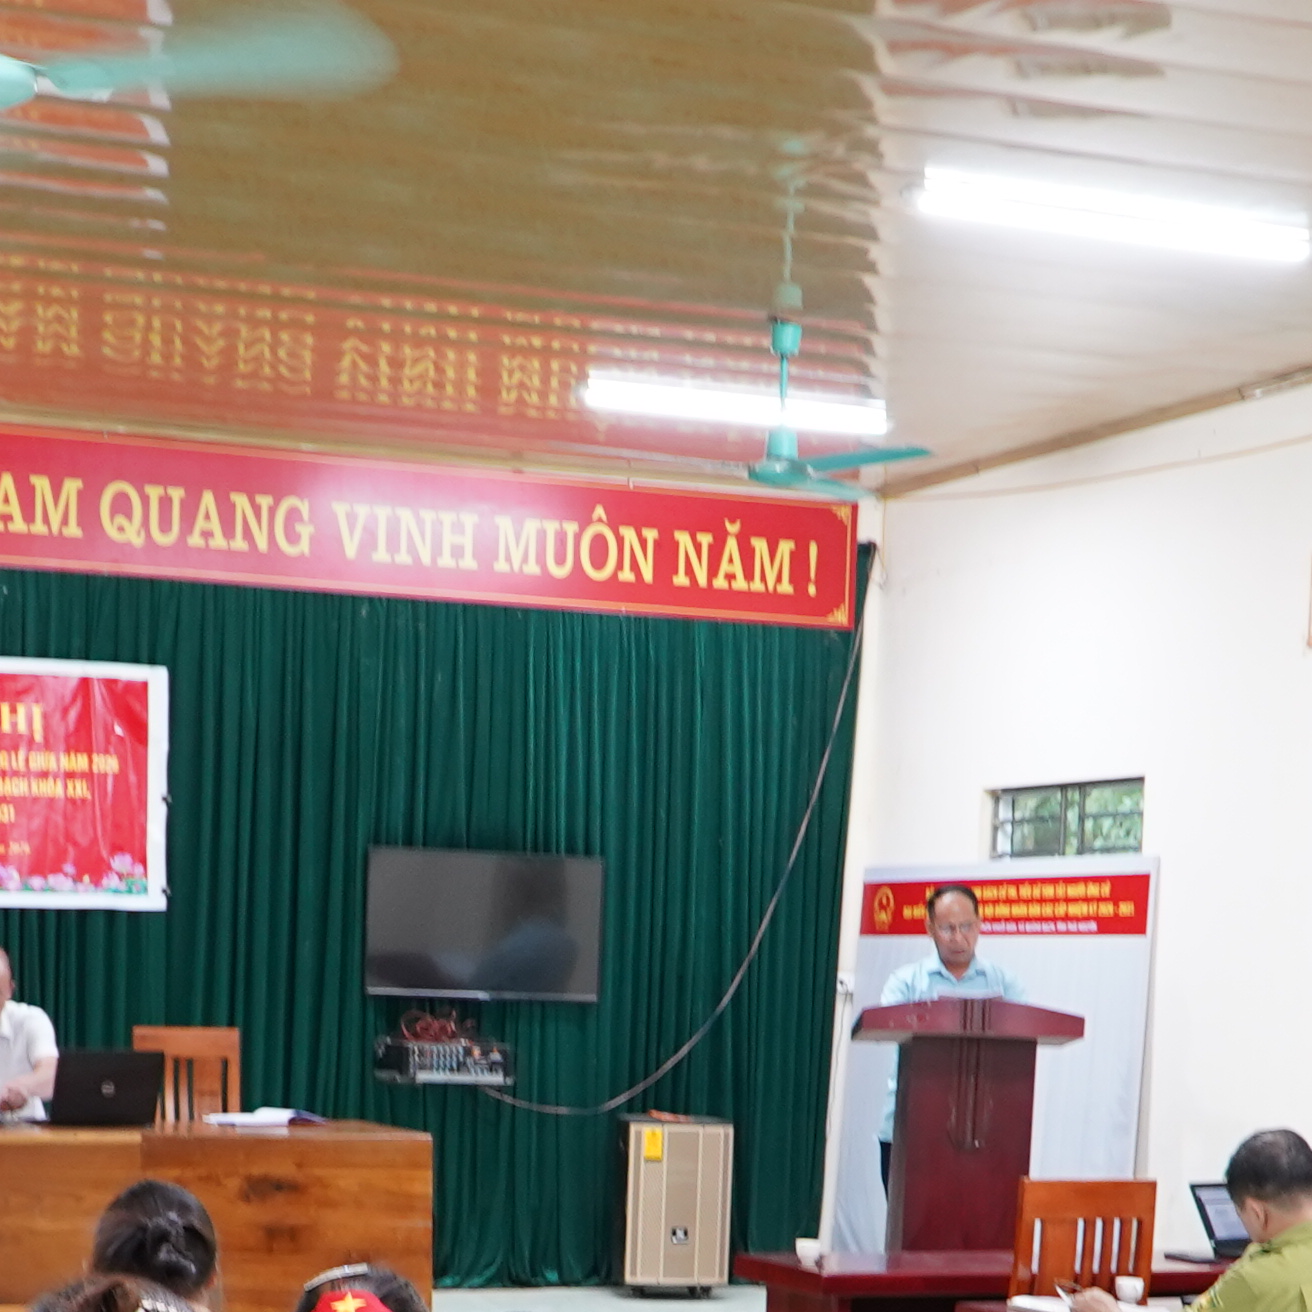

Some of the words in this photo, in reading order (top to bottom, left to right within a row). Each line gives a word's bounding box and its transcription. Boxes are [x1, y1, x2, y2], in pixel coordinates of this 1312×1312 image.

[99, 479, 315, 557] QUANG
[332, 502, 478, 570] VINH
[493, 504, 658, 583] MUÔN
[673, 518, 795, 595] NĂM
[807, 540, 819, 598] !
